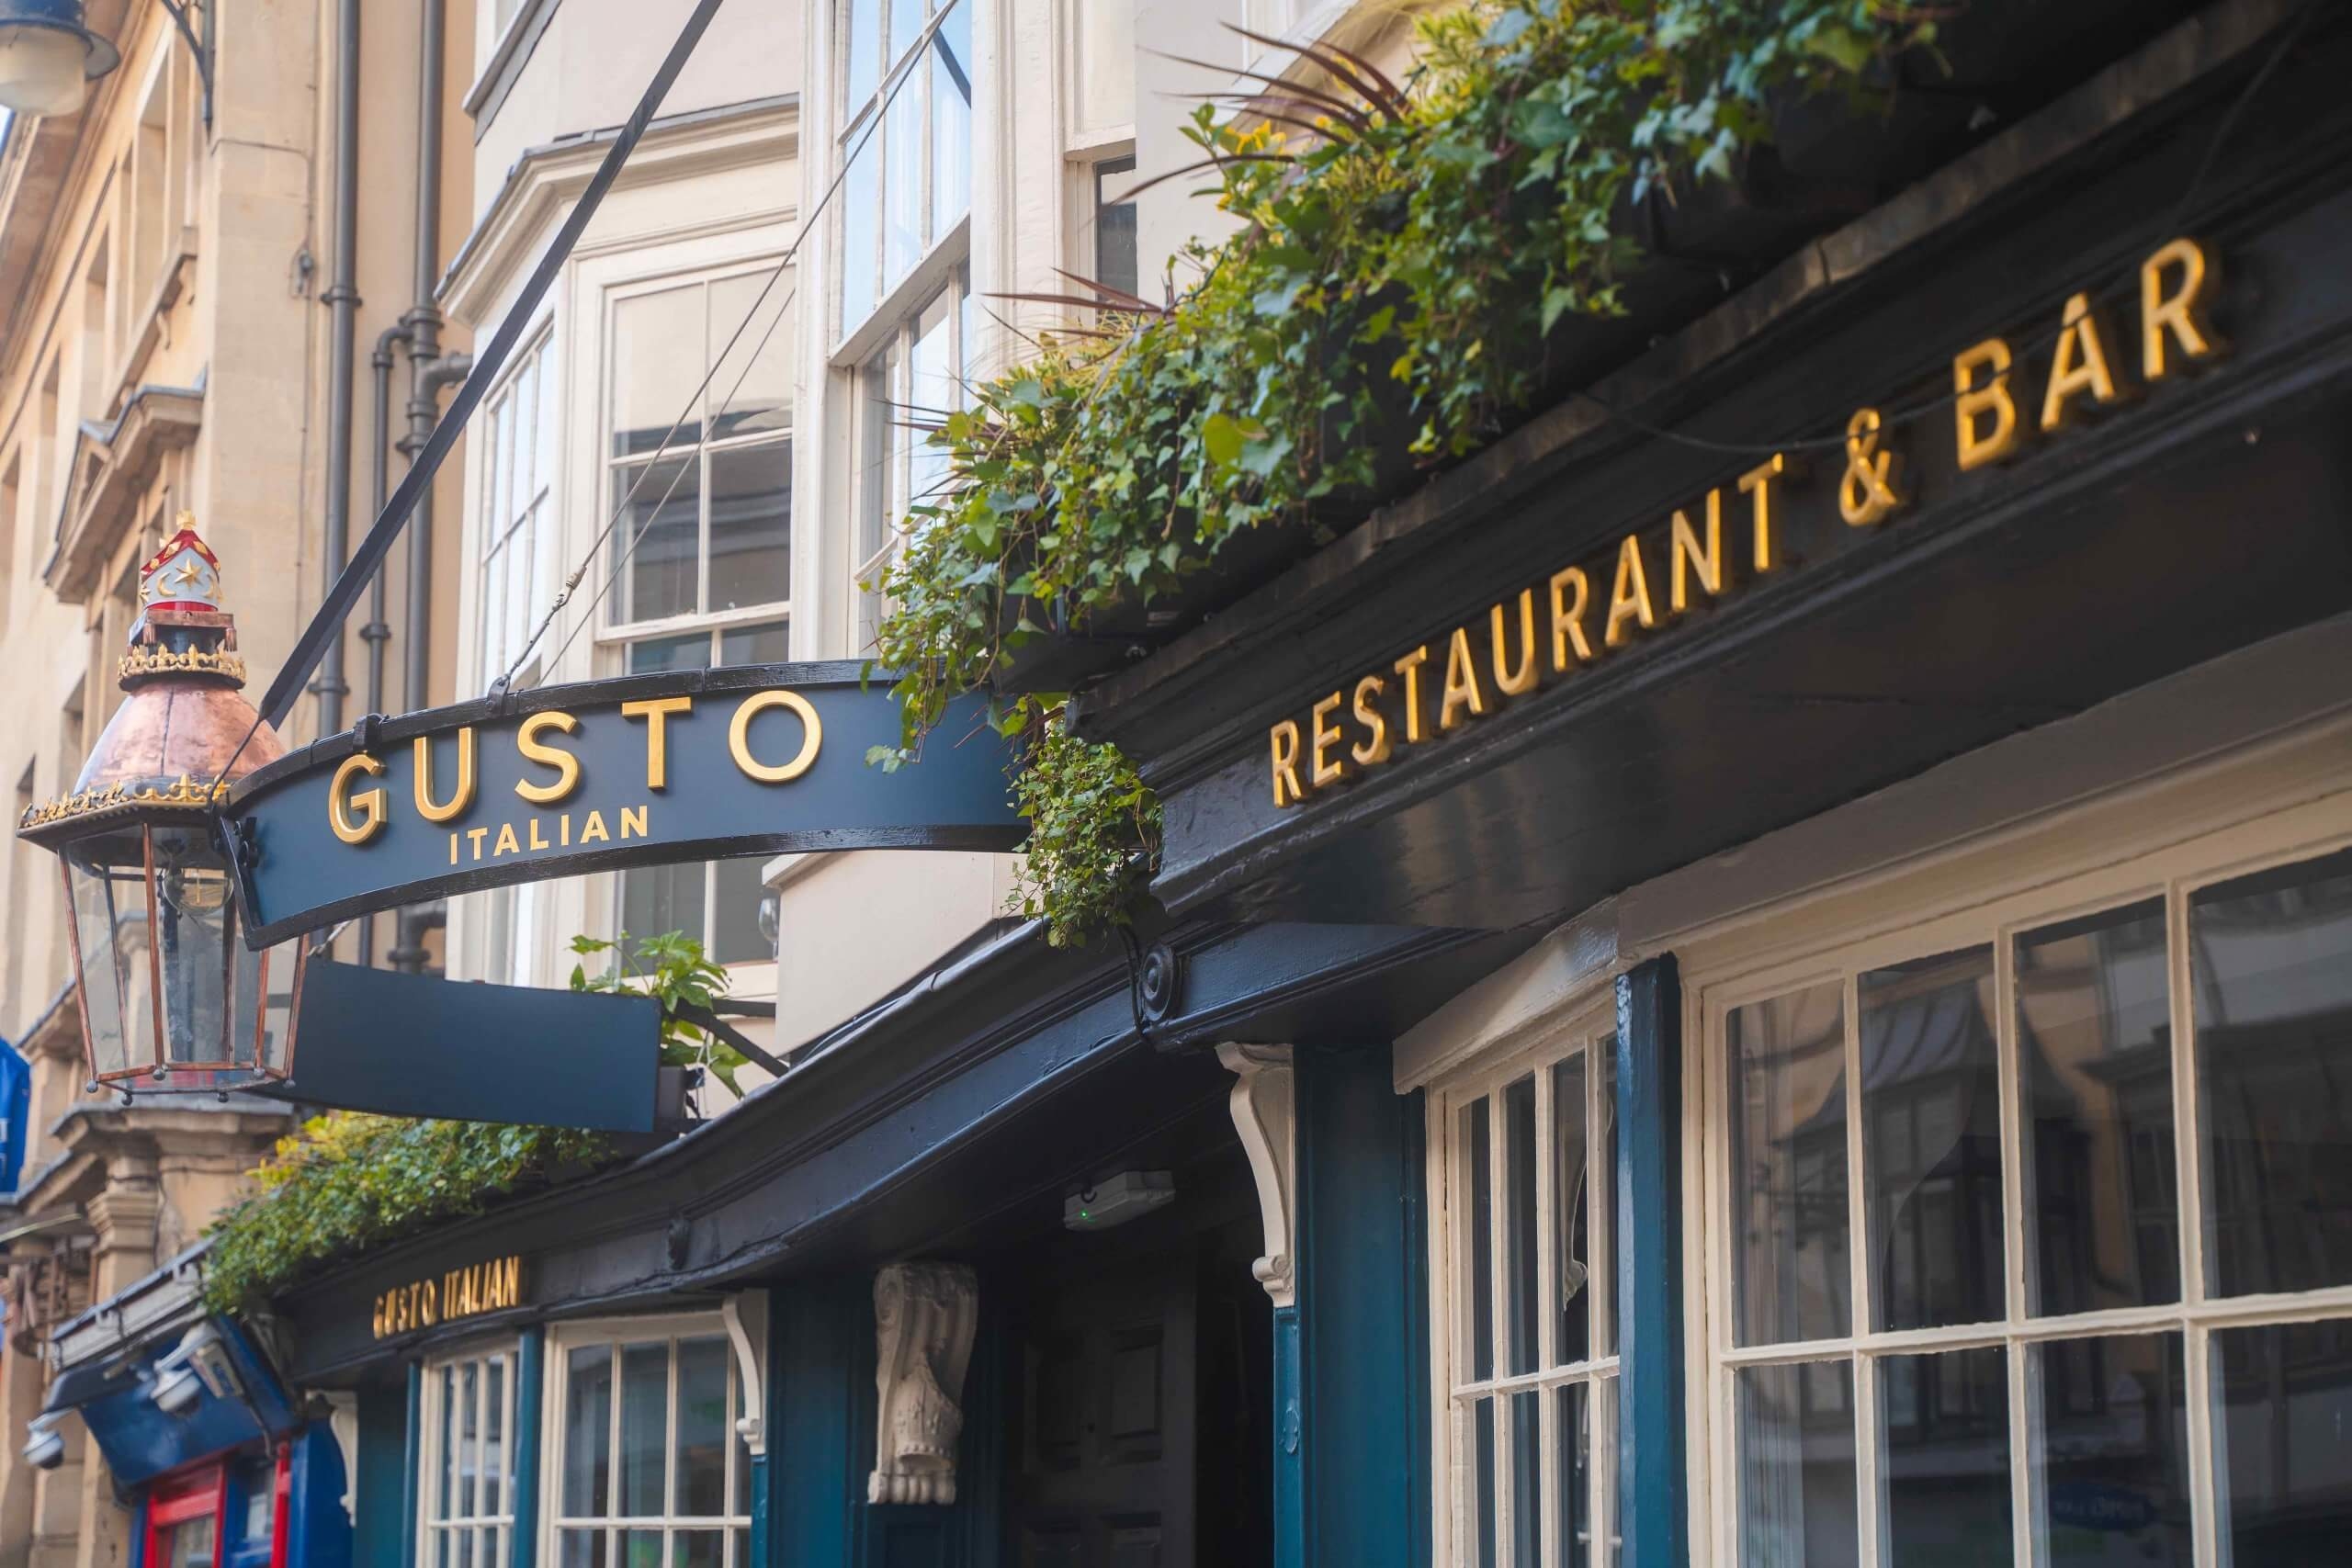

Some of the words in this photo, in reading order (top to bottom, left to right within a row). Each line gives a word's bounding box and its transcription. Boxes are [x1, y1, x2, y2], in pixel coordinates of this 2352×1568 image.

[1270, 453, 1784, 808] RESTAURANT
[1838, 408, 1898, 526] &
[1953, 237, 2210, 471] BAR
[328, 690, 823, 845] GUSTO
[450, 805, 648, 865] ITALIAN
[373, 1279, 437, 1340] GUSTO
[443, 1255, 521, 1321] ITALIAN
